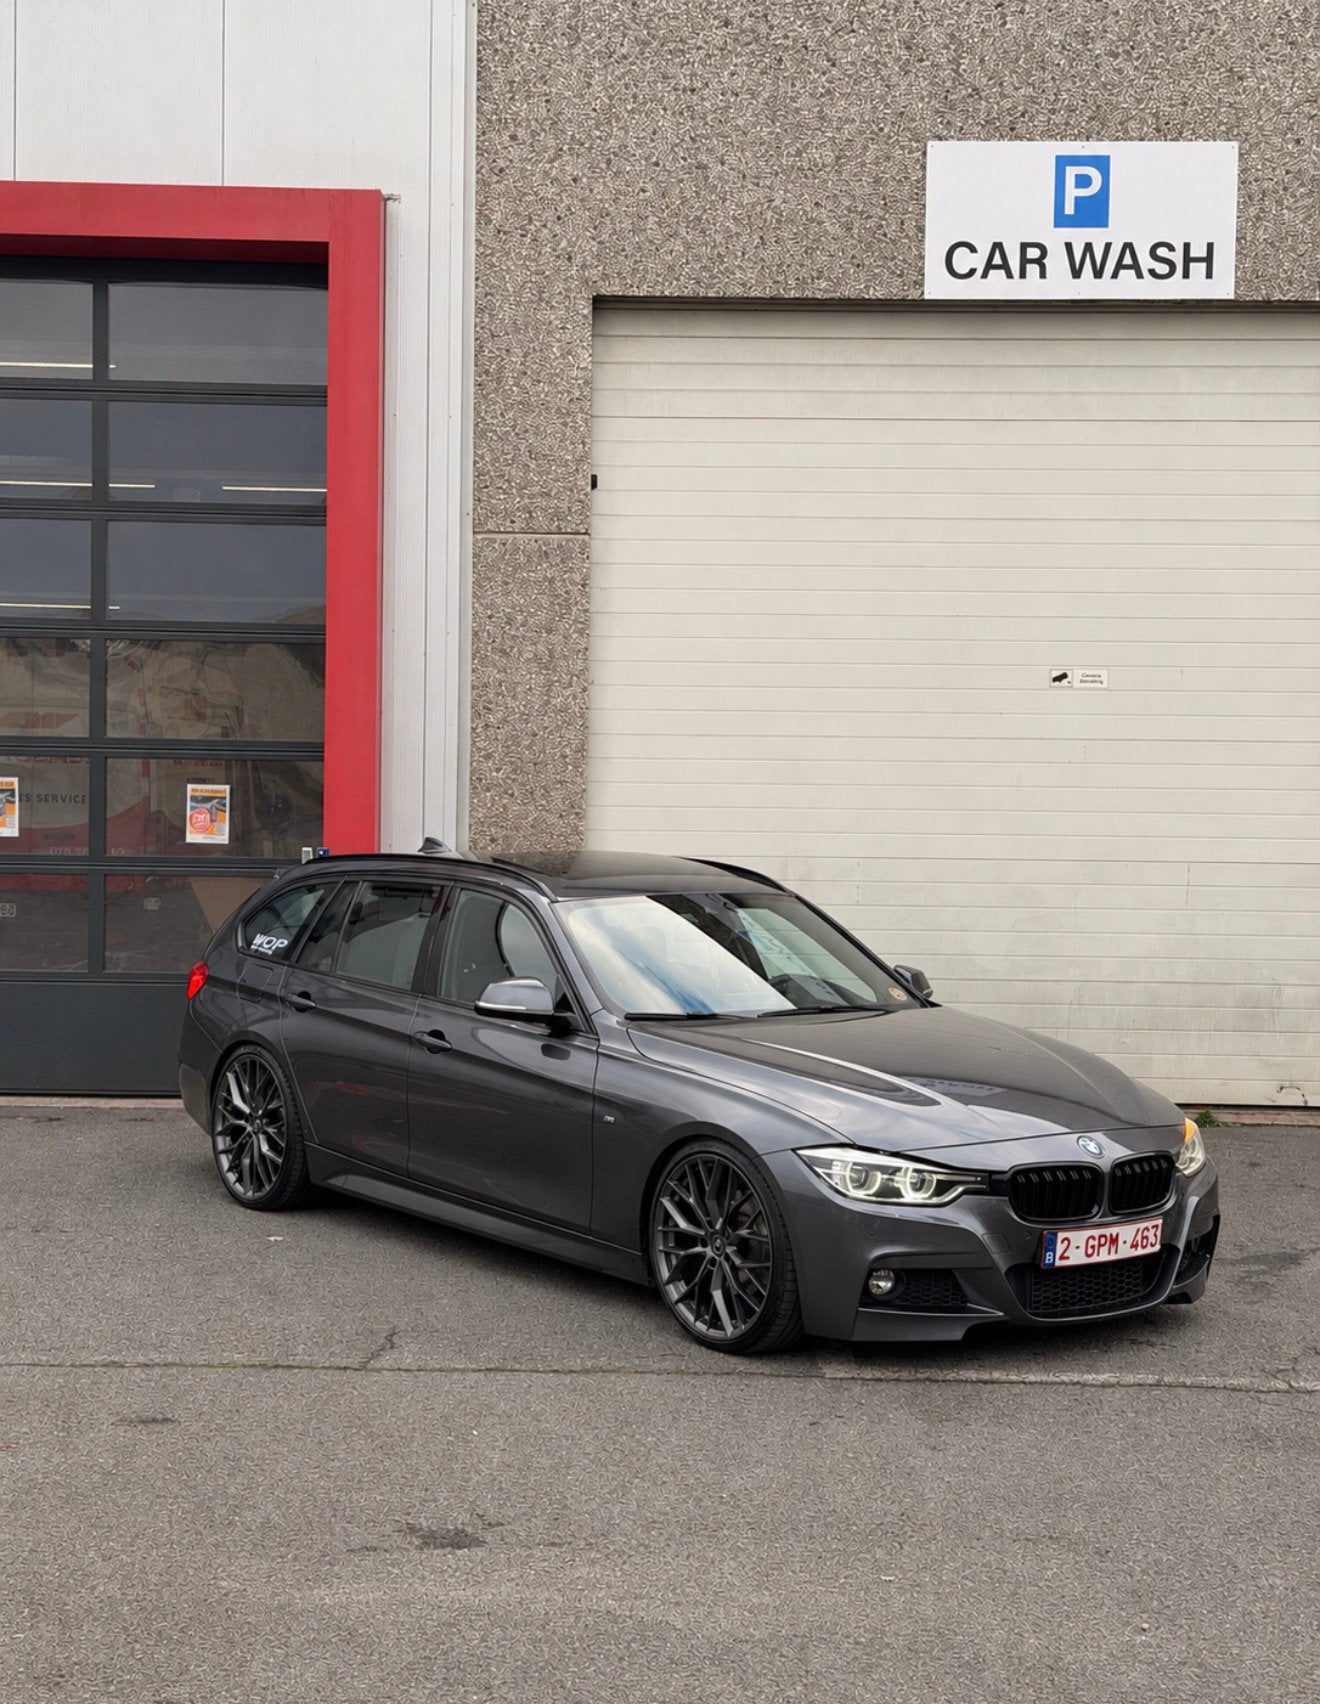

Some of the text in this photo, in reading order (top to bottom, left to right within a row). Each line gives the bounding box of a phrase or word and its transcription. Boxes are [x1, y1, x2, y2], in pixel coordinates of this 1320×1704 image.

[1064, 166, 1102, 215] P
[944, 241, 1214, 280] CAR WASH
[36, 793, 88, 804] SERVICE
[252, 933, 289, 951] WOP
[1045, 1251, 1054, 1264] B
